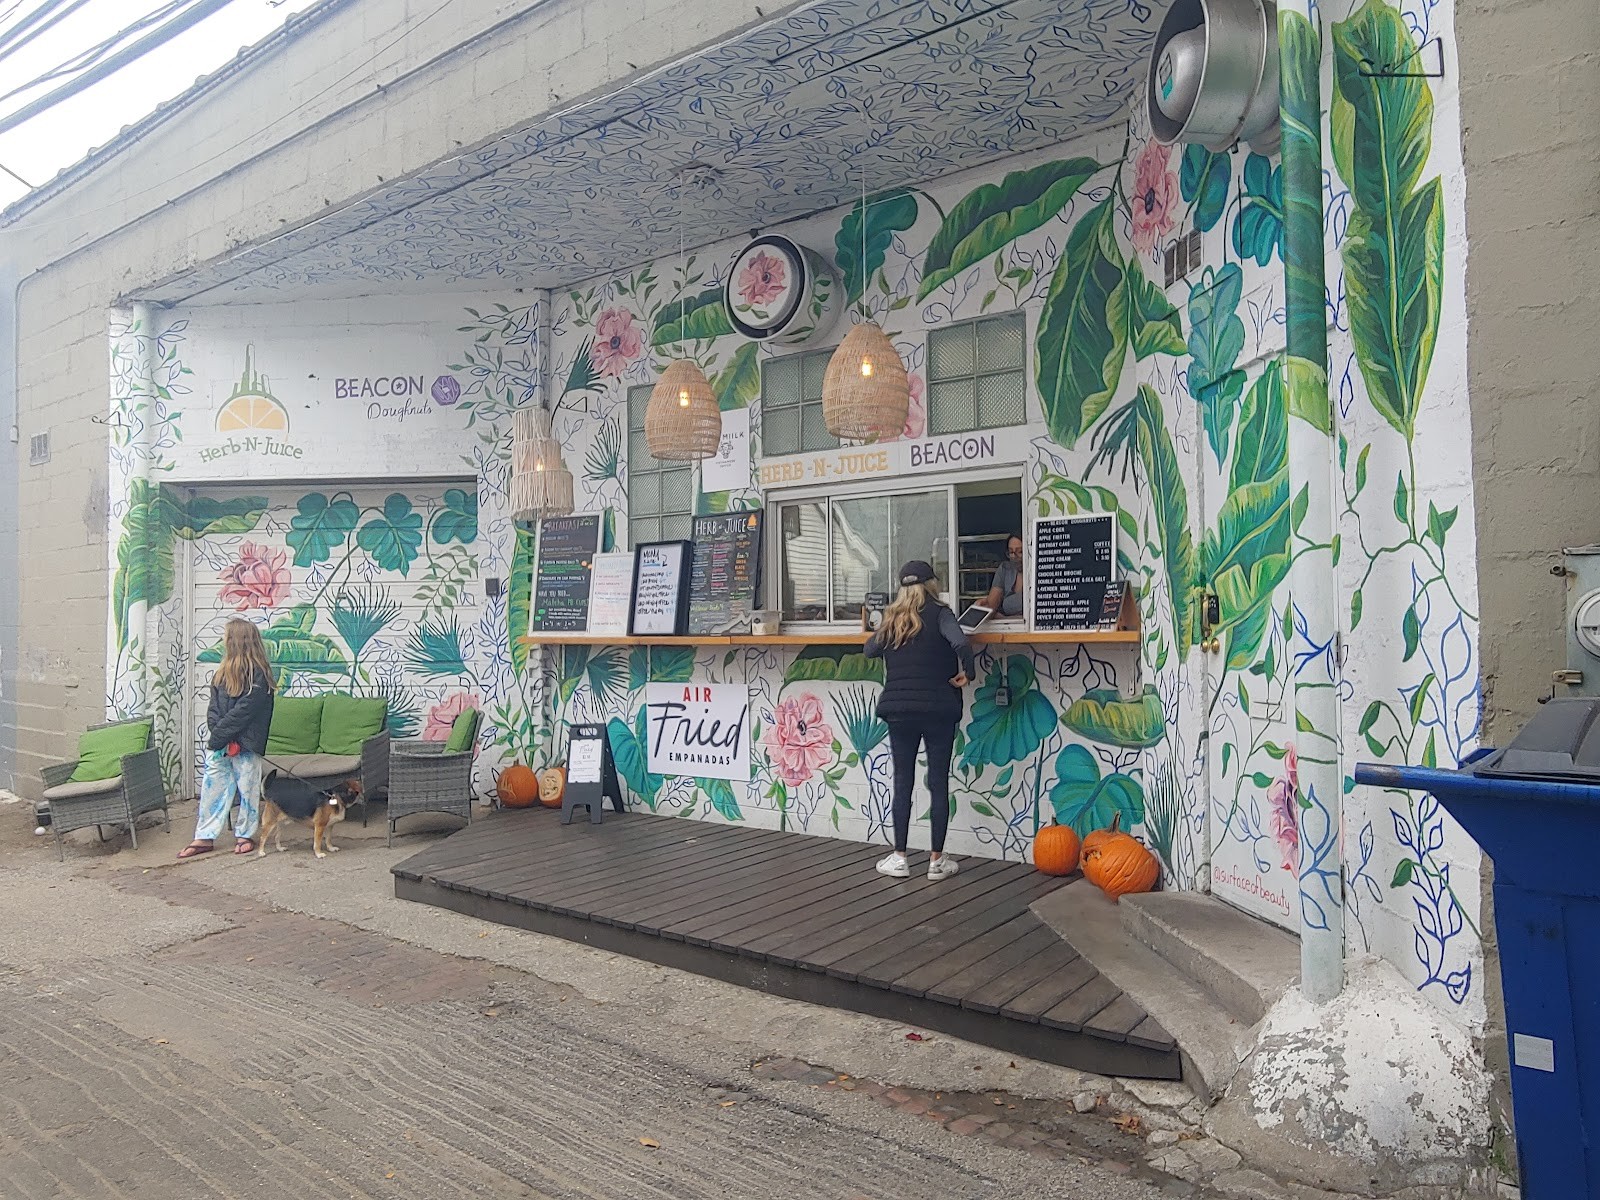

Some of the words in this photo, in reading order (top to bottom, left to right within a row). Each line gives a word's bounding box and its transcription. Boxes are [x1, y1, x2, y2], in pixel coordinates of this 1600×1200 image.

[335, 375, 424, 399] BEACON
[367, 398, 432, 422] Doughnuts
[910, 435, 994, 467] BEACON
[695, 520, 717, 536] HERB
[724, 518, 747, 533] JUICE
[683, 686, 712, 702] AIR
[648, 701, 747, 760] Fried
[669, 752, 730, 765] EMPANADAS
[1214, 864, 1290, 917] @surfaceofbeauty
